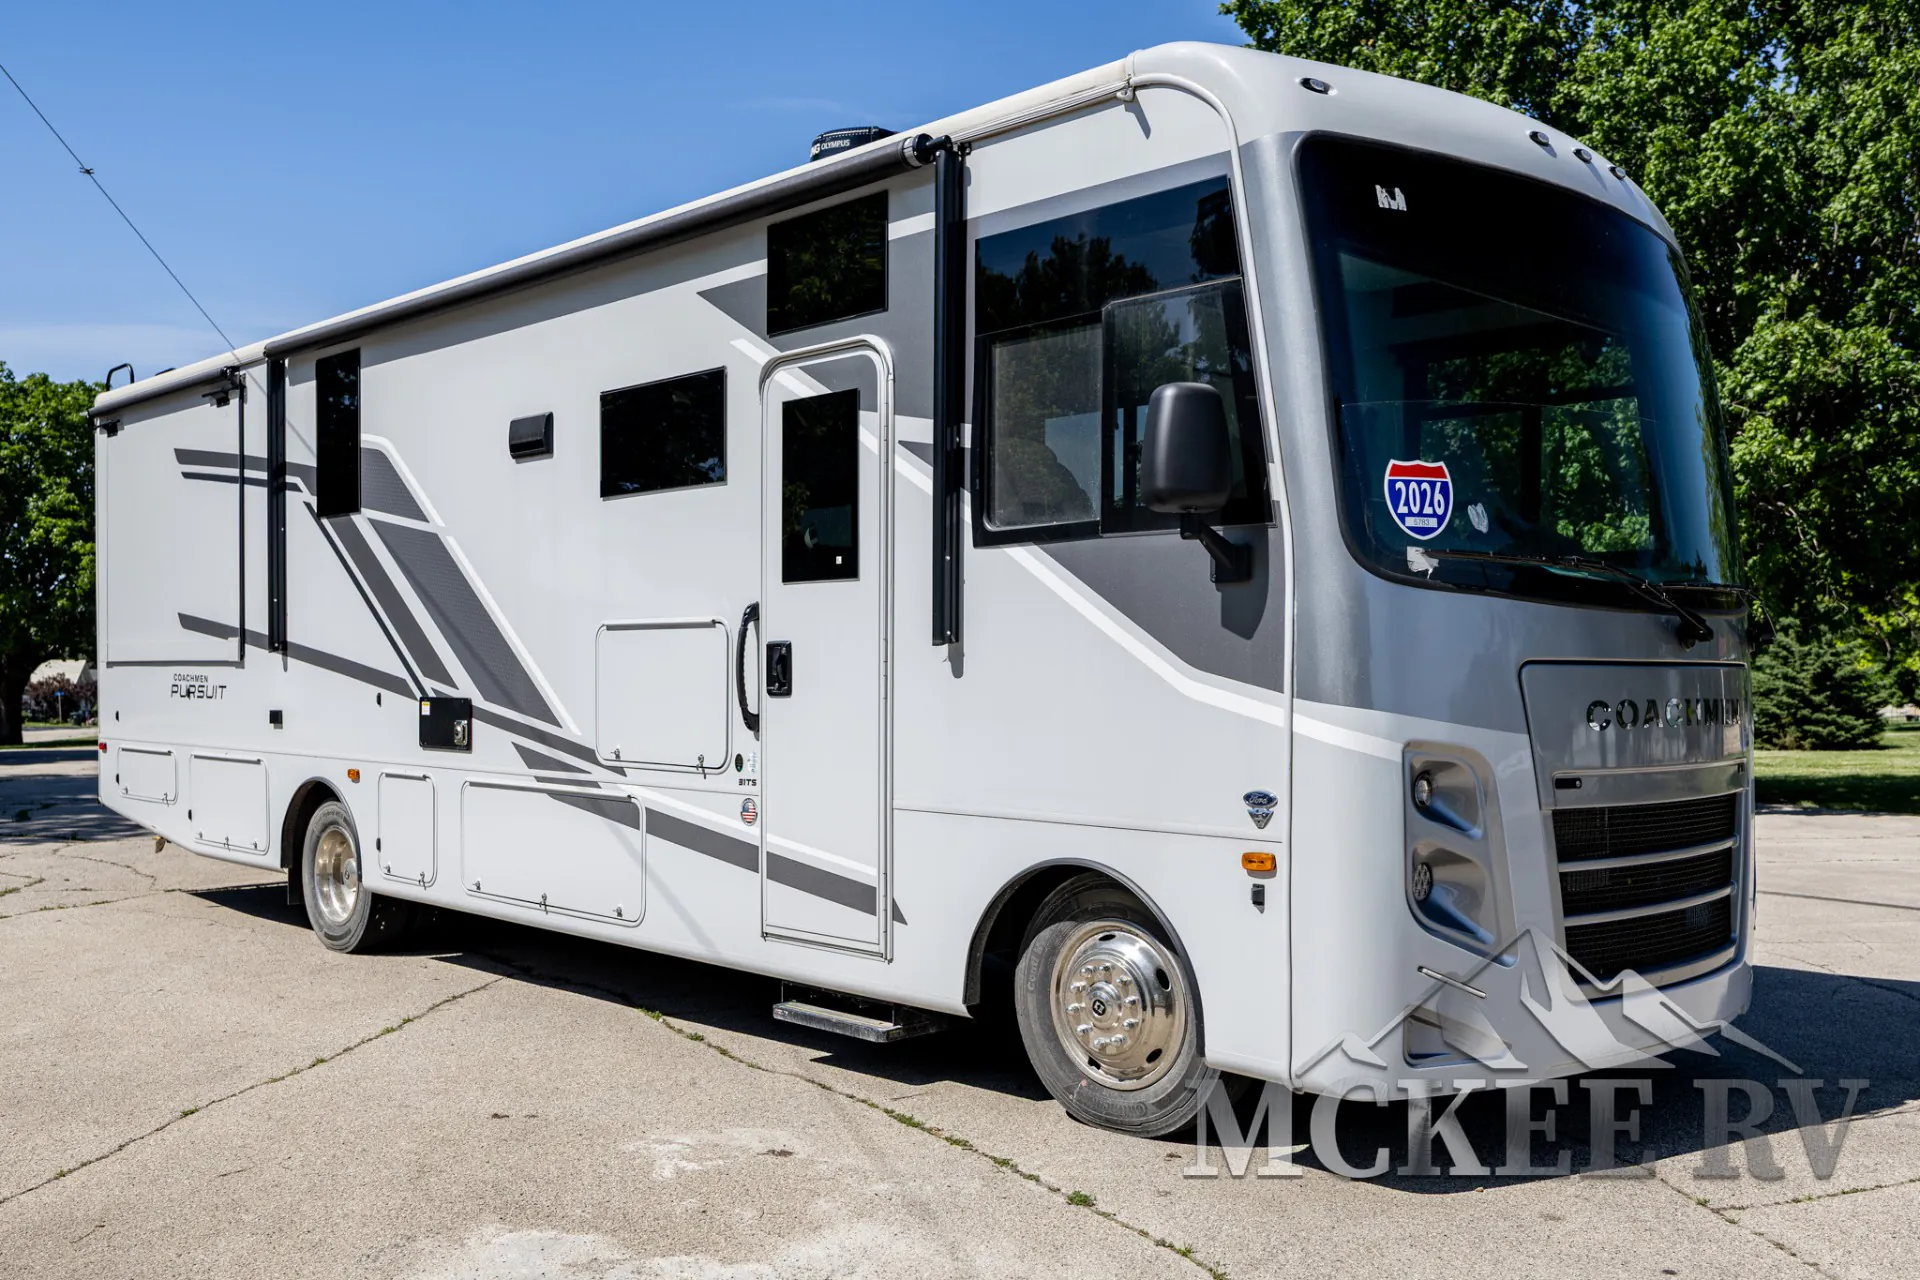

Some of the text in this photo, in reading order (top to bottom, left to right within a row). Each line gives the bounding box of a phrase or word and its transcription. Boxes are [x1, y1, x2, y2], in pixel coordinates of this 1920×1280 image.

[821, 139, 850, 149] OLYMPUS
[1395, 481, 1445, 515] 2026
[173, 673, 208, 683] COACHMEN
[171, 684, 227, 700] PURSUIT
[1587, 698, 1740, 731] COACHMEN
[1249, 793, 1268, 804] Ford
